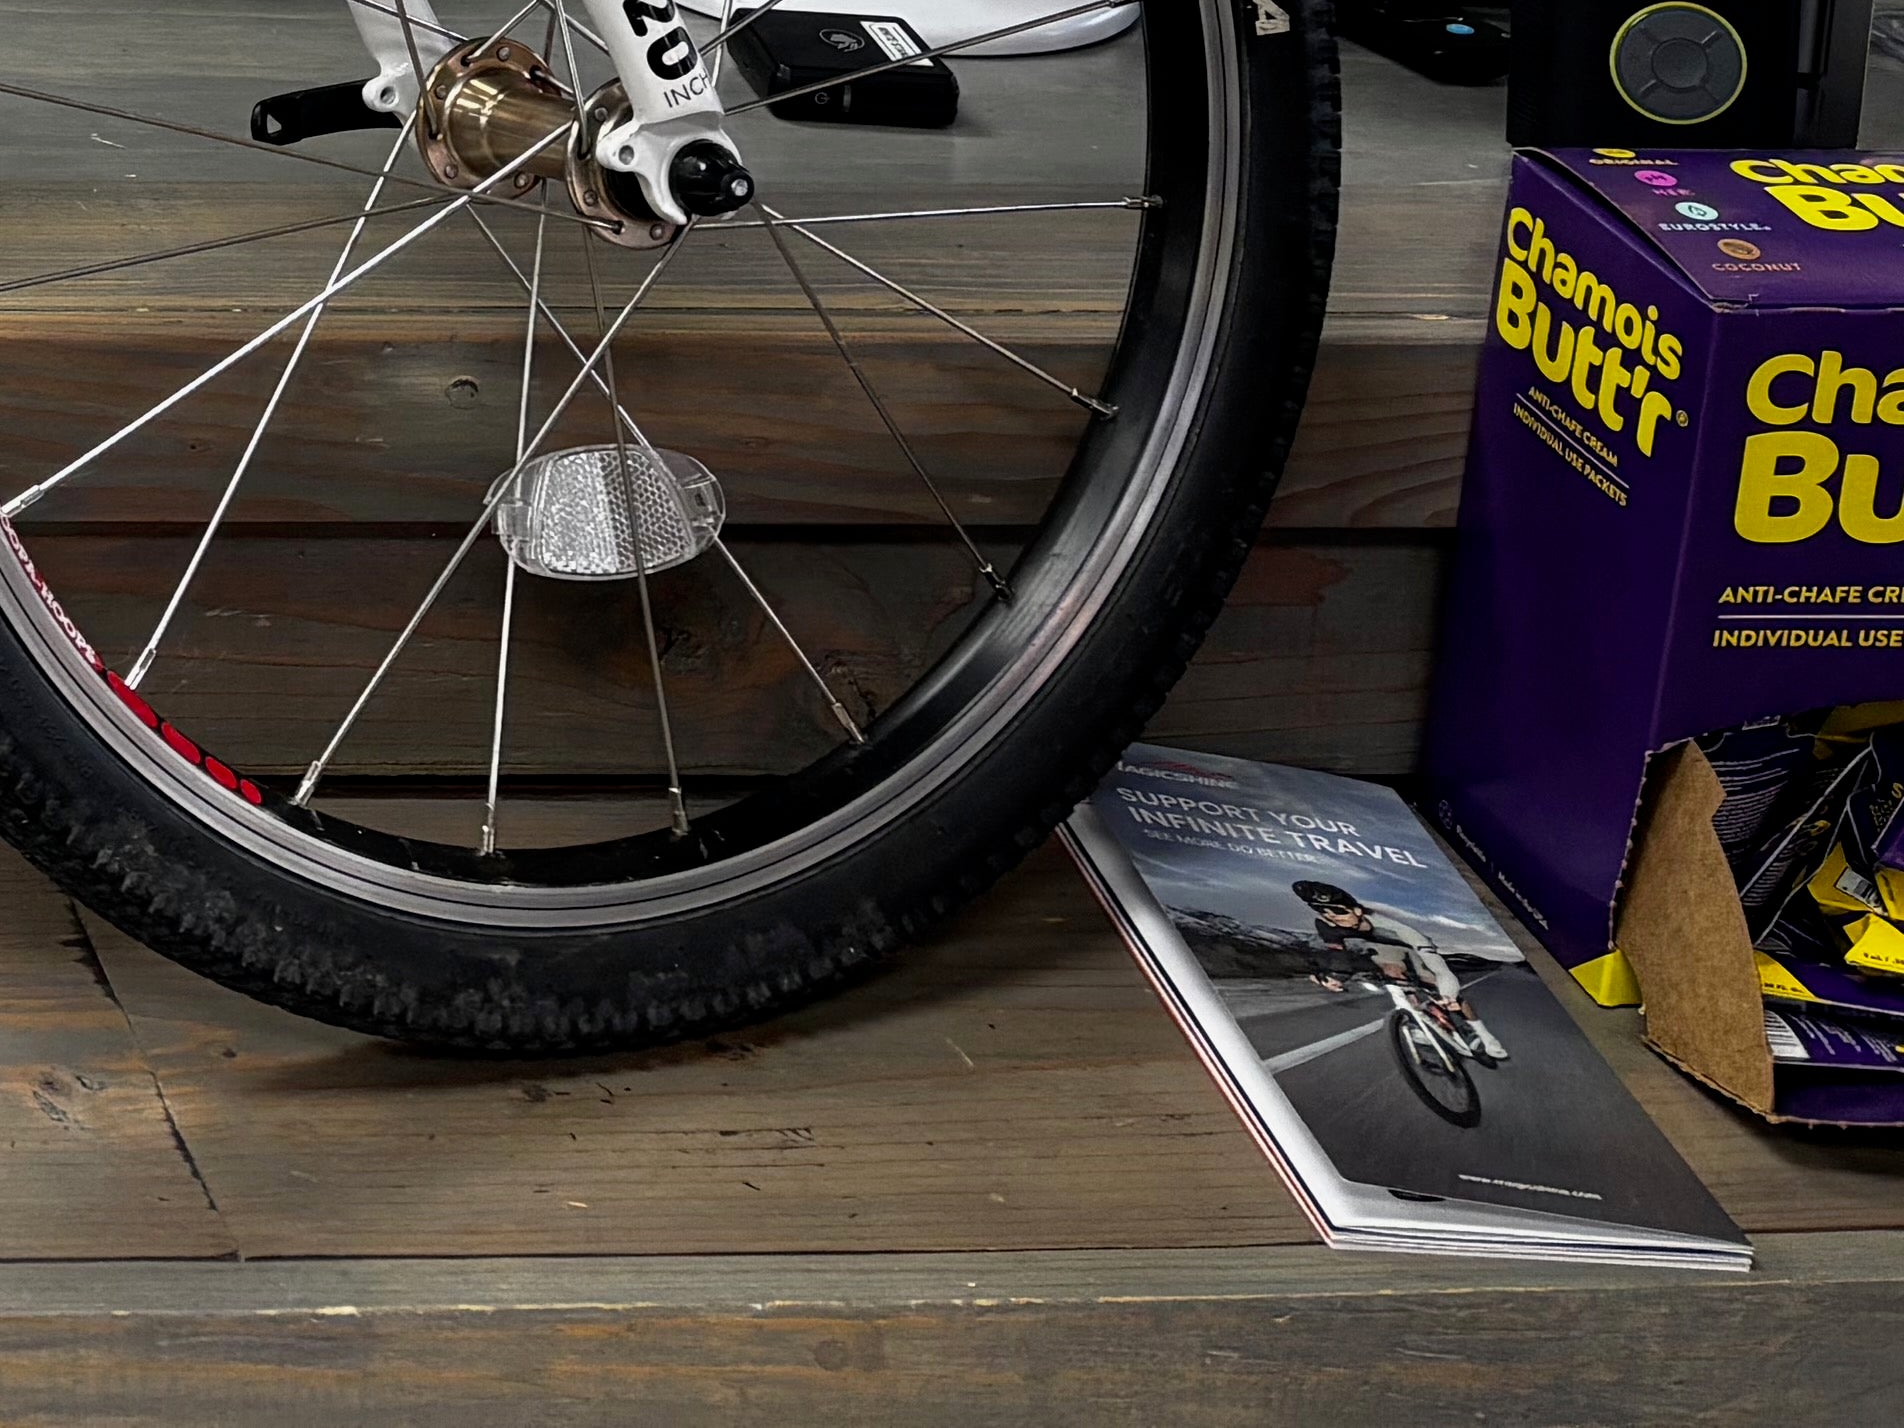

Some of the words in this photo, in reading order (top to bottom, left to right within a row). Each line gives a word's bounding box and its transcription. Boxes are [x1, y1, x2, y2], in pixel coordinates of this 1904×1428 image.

[663, 70, 711, 109] INCH
[1506, 205, 1683, 381] Chamois
[1711, 262, 1801, 272] COCONUT
[1495, 256, 1673, 458] Butt'r
[1528, 385, 1583, 438] ANTI-CHAFE
[1582, 430, 1618, 467] CREAM
[1513, 401, 1564, 456] INDIVIDUAL
[1565, 447, 1583, 472] USE
[1583, 463, 1627, 507] PACKETS
[1717, 585, 1863, 605] ANTI-CHAFE
[1867, 585, 1904, 605] CR
[1712, 629, 1853, 649] INDIVIDUAL
[1857, 629, 1904, 649] USE
[1115, 787, 1261, 823] SUPPORT
[1265, 810, 1361, 839] YOUR
[1127, 806, 1280, 844] INFINITE
[1285, 830, 1429, 871] TRAVEL
[1143, 828, 1174, 844] SEE
[1228, 842, 1252, 855] DO
[1253, 846, 1321, 864] BETTER
